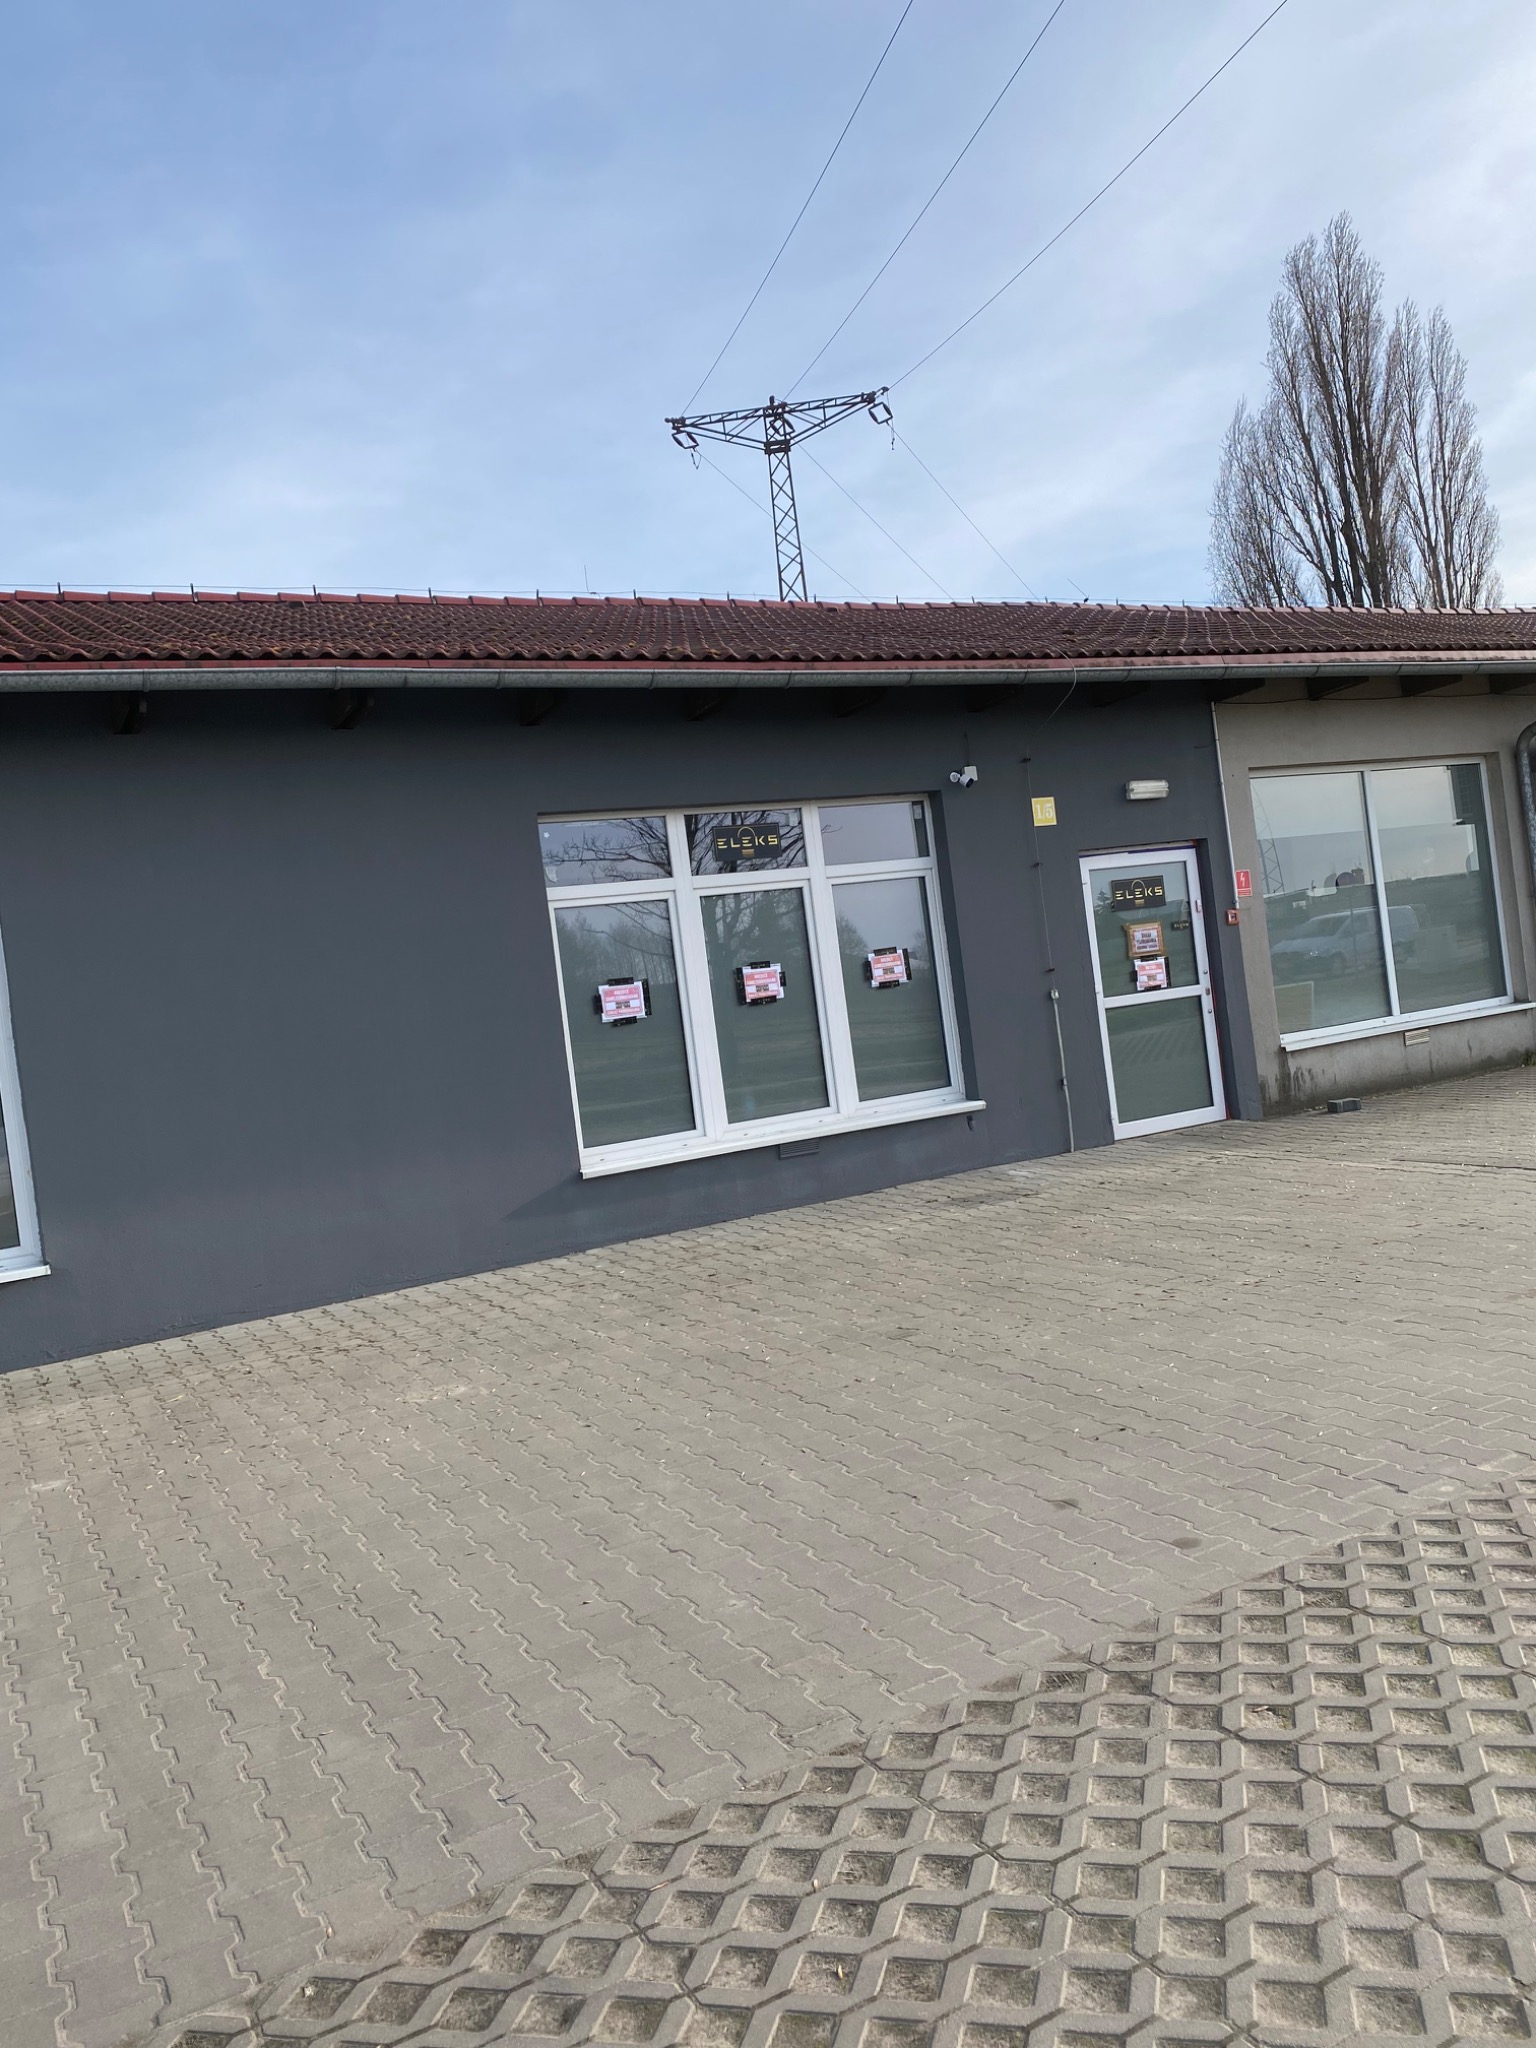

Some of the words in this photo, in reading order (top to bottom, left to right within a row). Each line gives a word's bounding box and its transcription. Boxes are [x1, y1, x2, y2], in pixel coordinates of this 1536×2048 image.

[1035, 803, 1053, 819] 1/5
[717, 834, 778, 849] ELEKS
[1115, 886, 1163, 900] ELEKS
